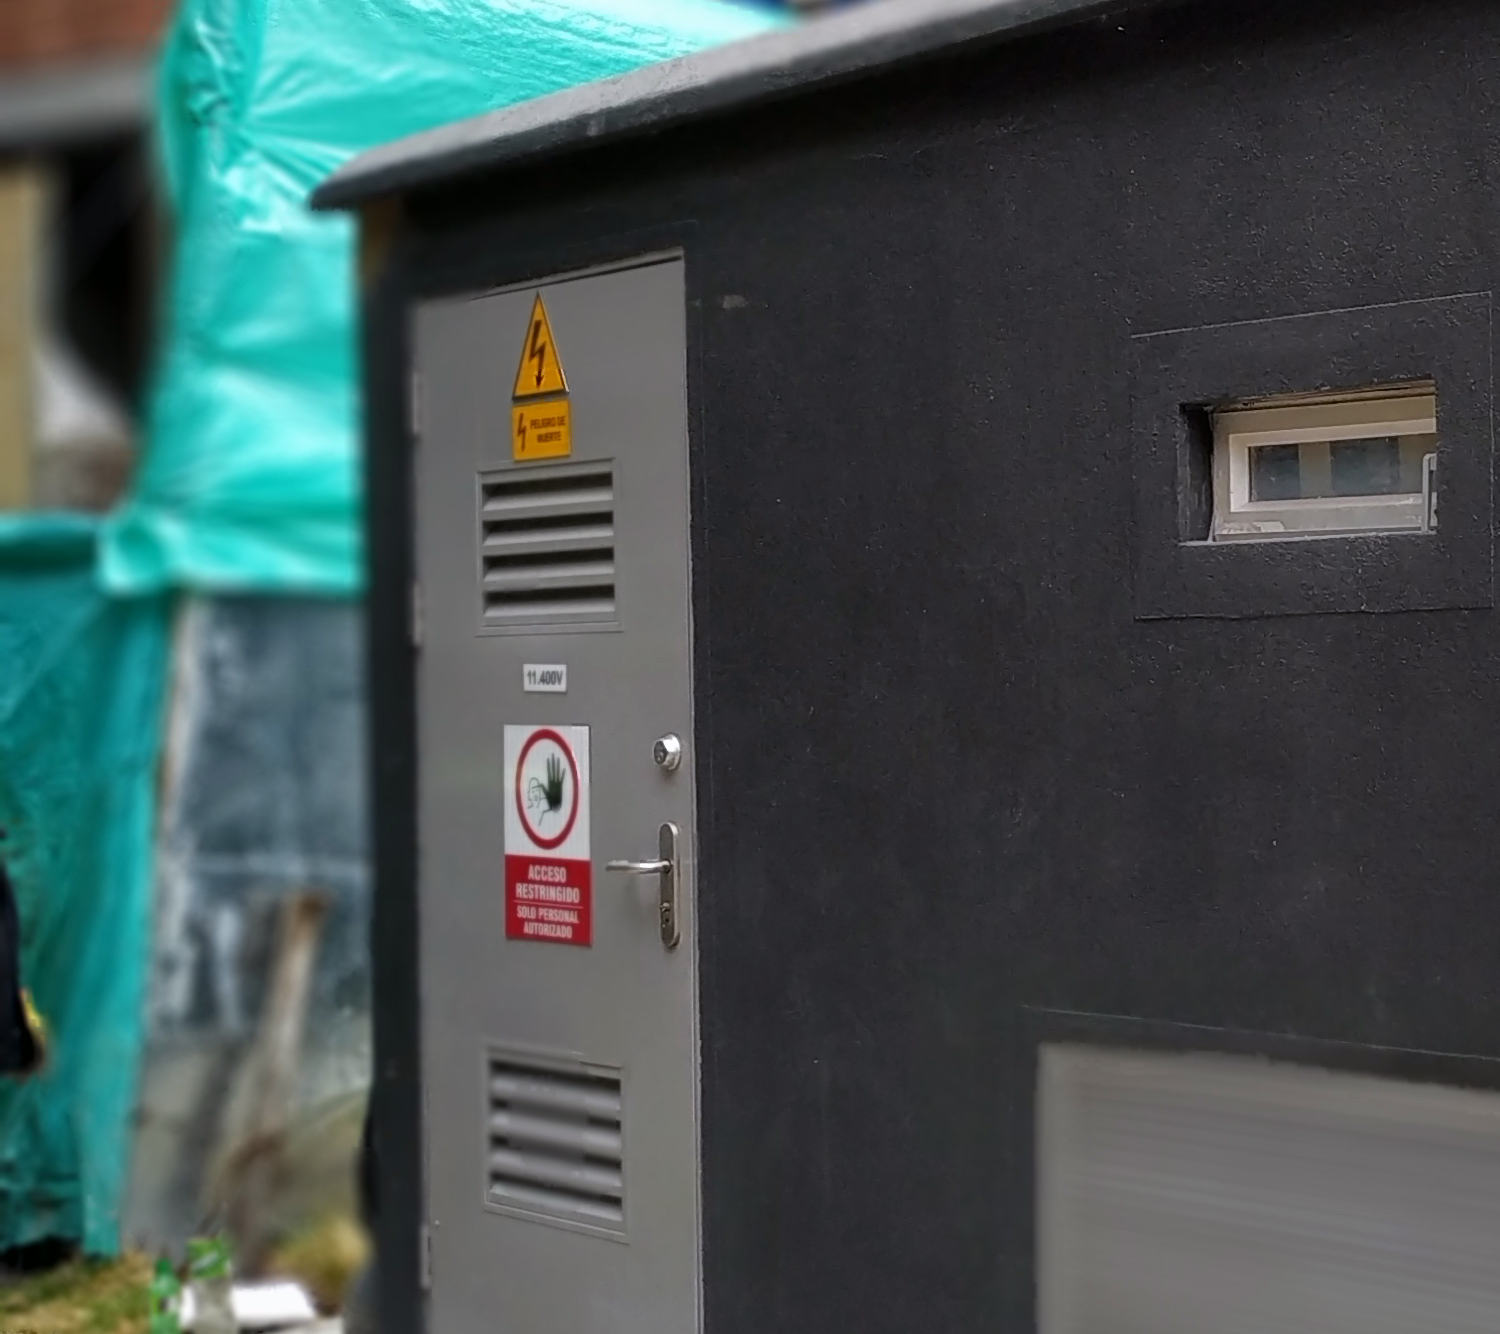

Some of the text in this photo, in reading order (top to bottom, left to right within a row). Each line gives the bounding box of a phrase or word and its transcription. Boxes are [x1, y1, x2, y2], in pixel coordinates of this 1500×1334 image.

[527, 669, 564, 686] 11.400V
[528, 864, 567, 883] ACCESO
[515, 882, 580, 904] RESTRINGIDO
[517, 905, 580, 924] SOLO PERSONAL
[523, 921, 573, 939] AUTORIZADO
